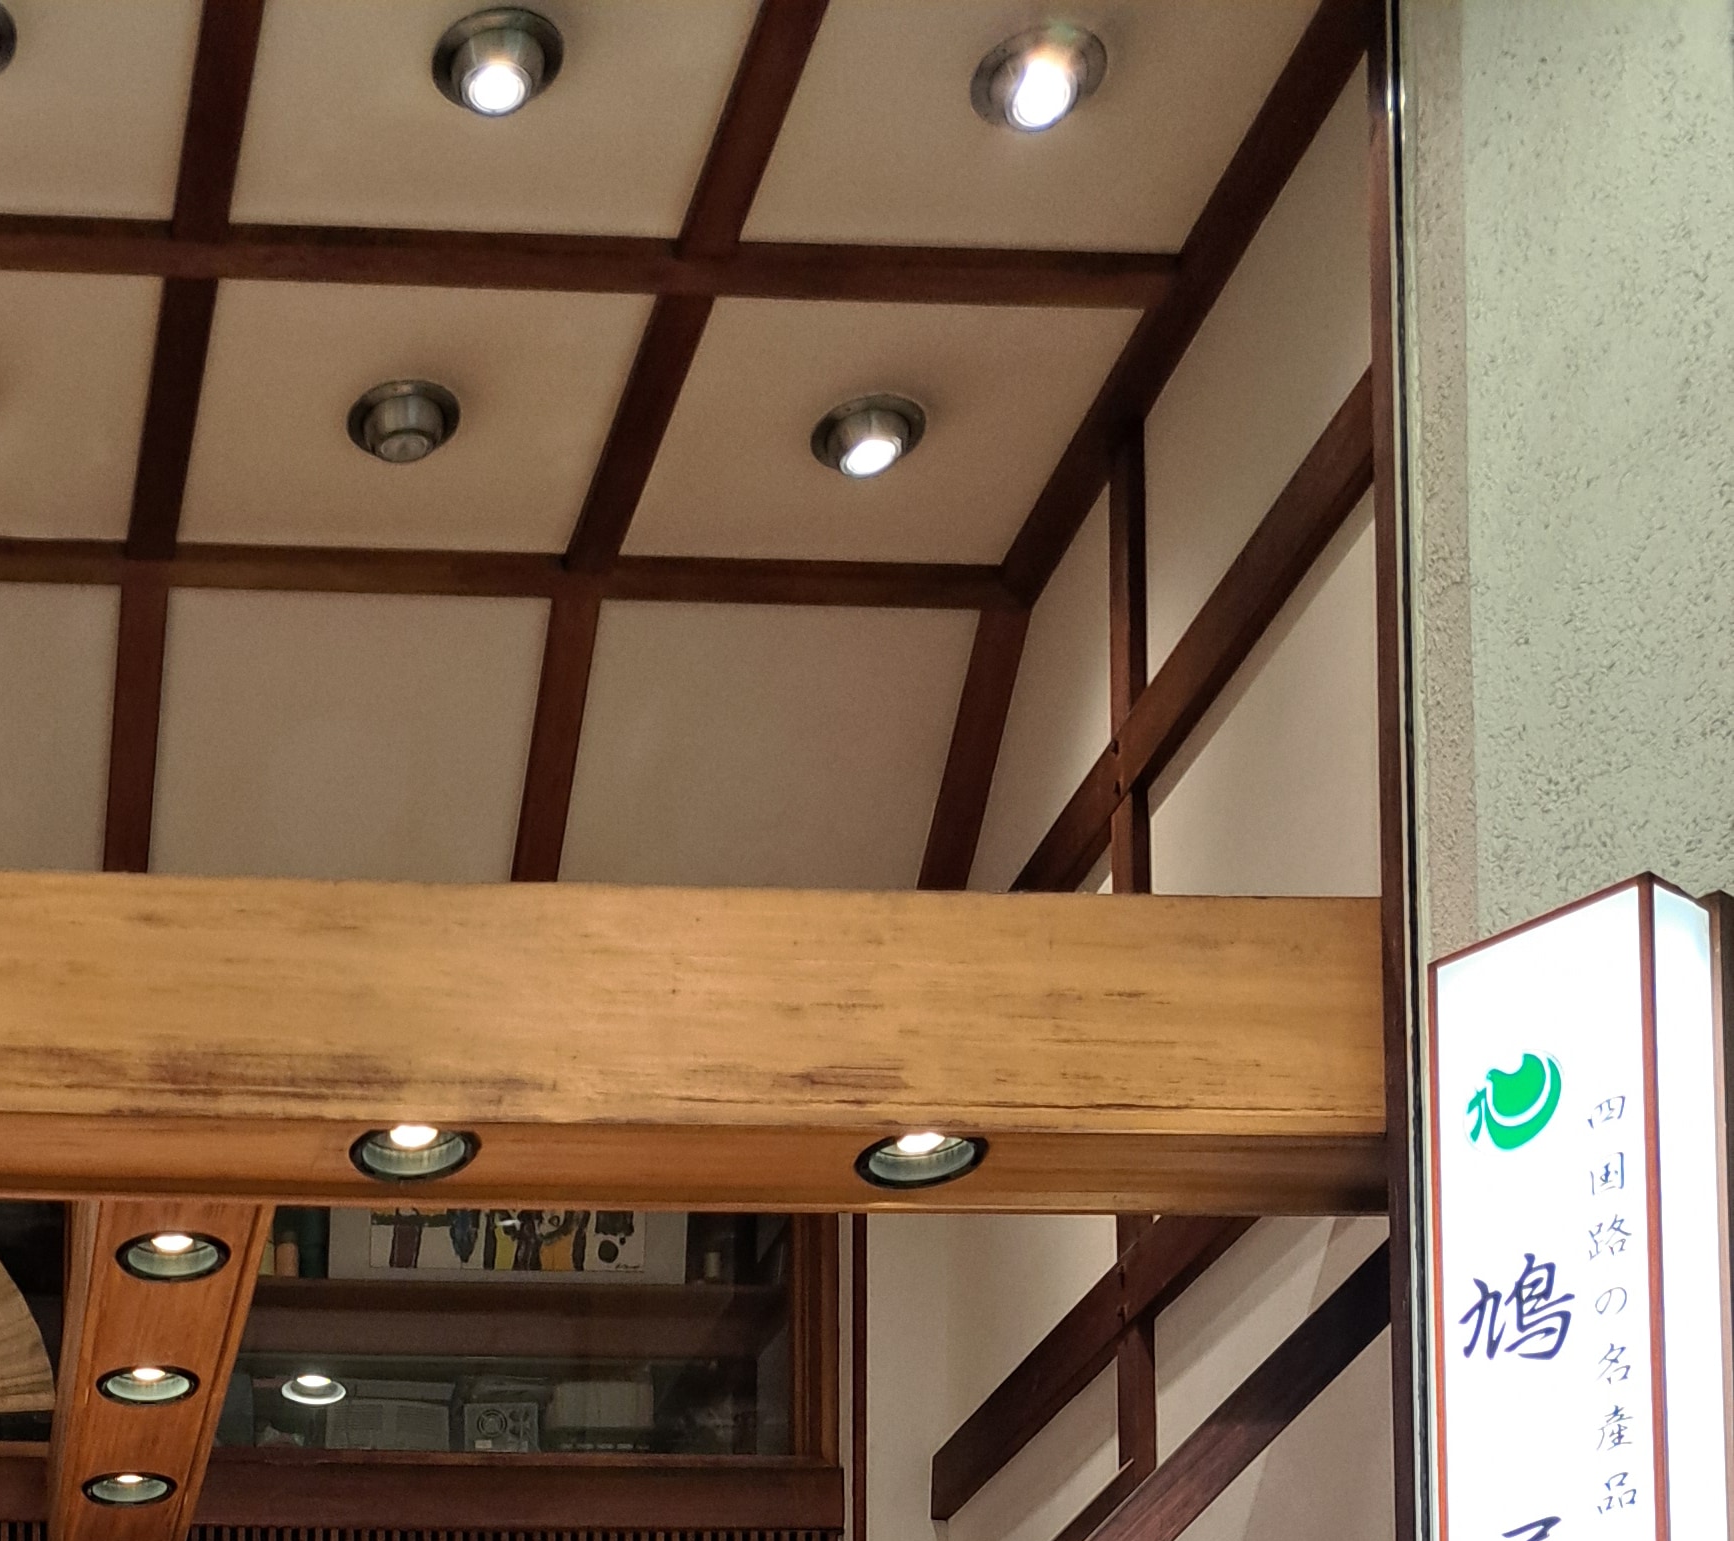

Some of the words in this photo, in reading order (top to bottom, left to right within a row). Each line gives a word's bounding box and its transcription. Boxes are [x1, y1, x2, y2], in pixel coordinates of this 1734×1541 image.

[1586, 1094, 1638, 1515] 四国路の名産品
